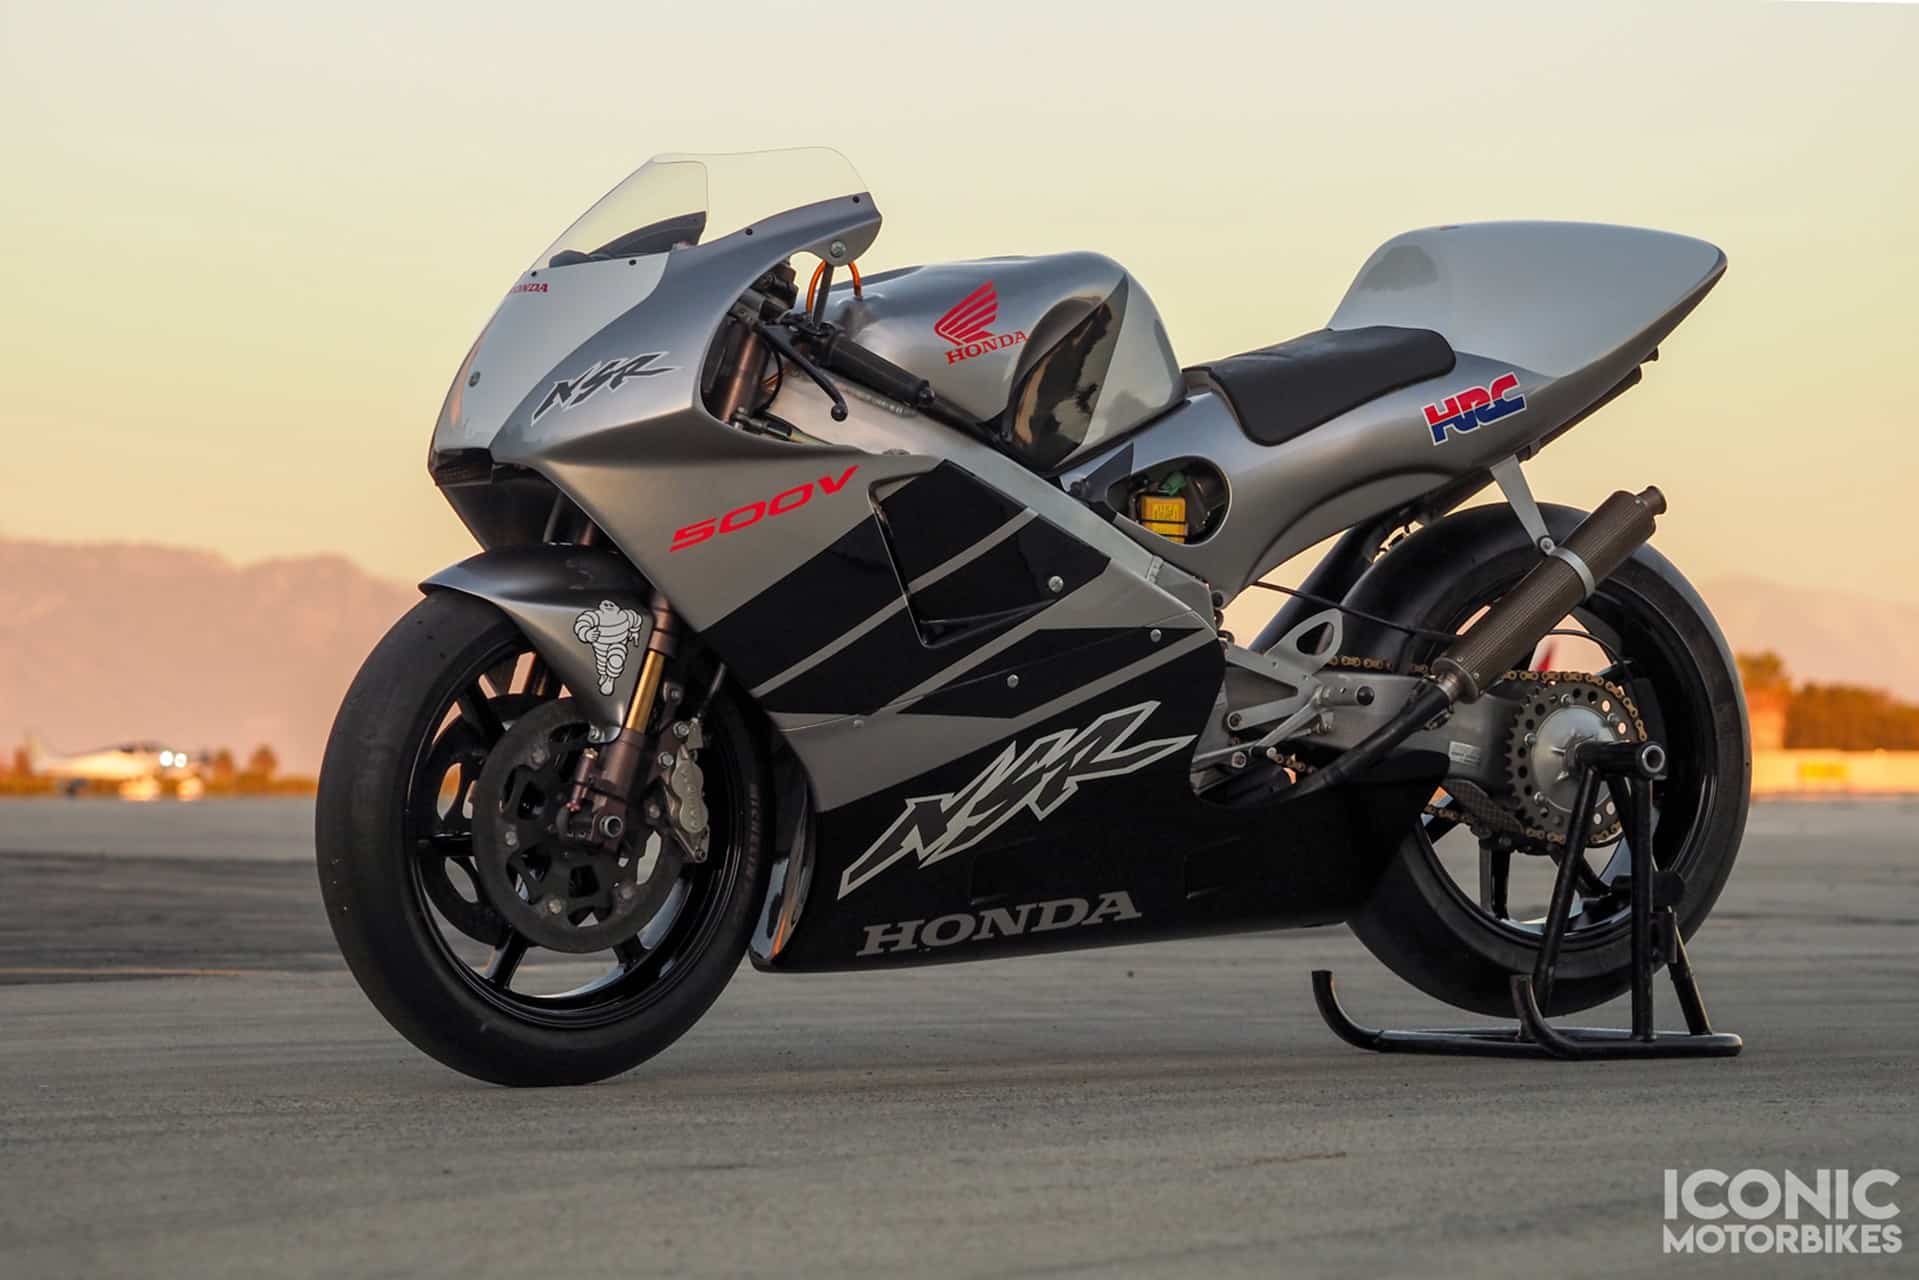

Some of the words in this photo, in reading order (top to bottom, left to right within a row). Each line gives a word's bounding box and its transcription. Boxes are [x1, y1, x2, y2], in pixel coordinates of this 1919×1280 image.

[944, 330, 1029, 366] HONDA
[531, 351, 685, 427] NSR
[1422, 371, 1527, 445] HRC
[669, 464, 860, 553] 500V
[837, 700, 1198, 900] NSR
[856, 890, 1142, 956] HONDA
